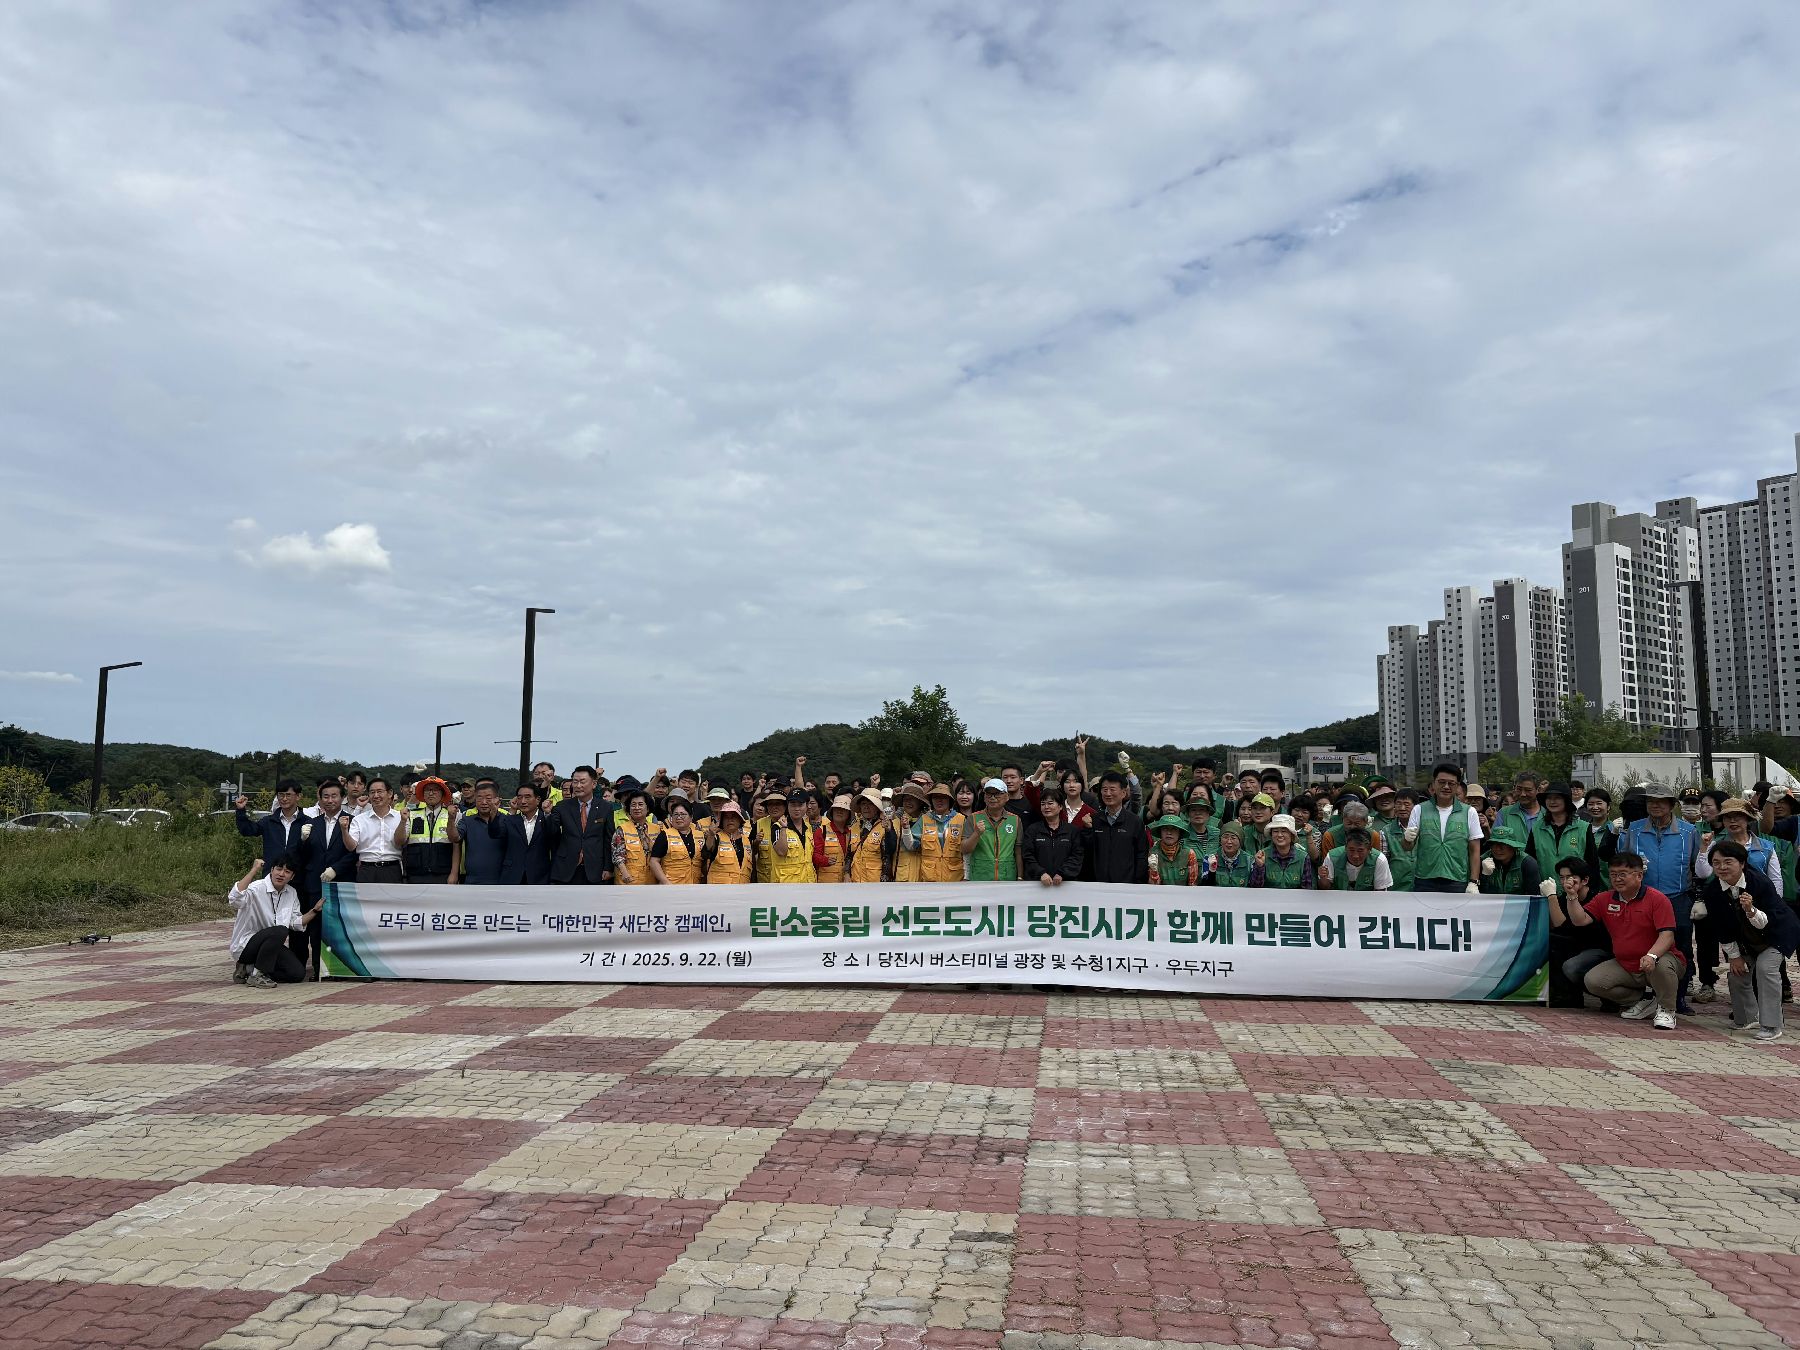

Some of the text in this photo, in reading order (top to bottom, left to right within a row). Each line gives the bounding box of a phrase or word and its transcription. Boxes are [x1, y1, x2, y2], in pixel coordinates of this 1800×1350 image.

[1578, 586, 1590, 594] 201
[378, 912, 426, 933] 모두의
[430, 912, 479, 933] 힘으로
[483, 913, 532, 933] 만드는
[618, 913, 671, 934] 새단장
[749, 904, 1473, 953] 탄소중립 선도도시! 당진시가 함께 만들어 갑니다!
[632, 952, 675, 967] 2025.
[679, 952, 693, 967] 9.
[697, 952, 721, 967] 22.
[726, 950, 753, 968] (월)
[878, 951, 924, 968] 당진시
[930, 952, 1008, 969] 버스터미널
[1013, 953, 1046, 970] 광장
[1051, 953, 1067, 970] 및
[1070, 954, 1149, 973] 수청1지구
[1166, 958, 1235, 978] 우두지구
